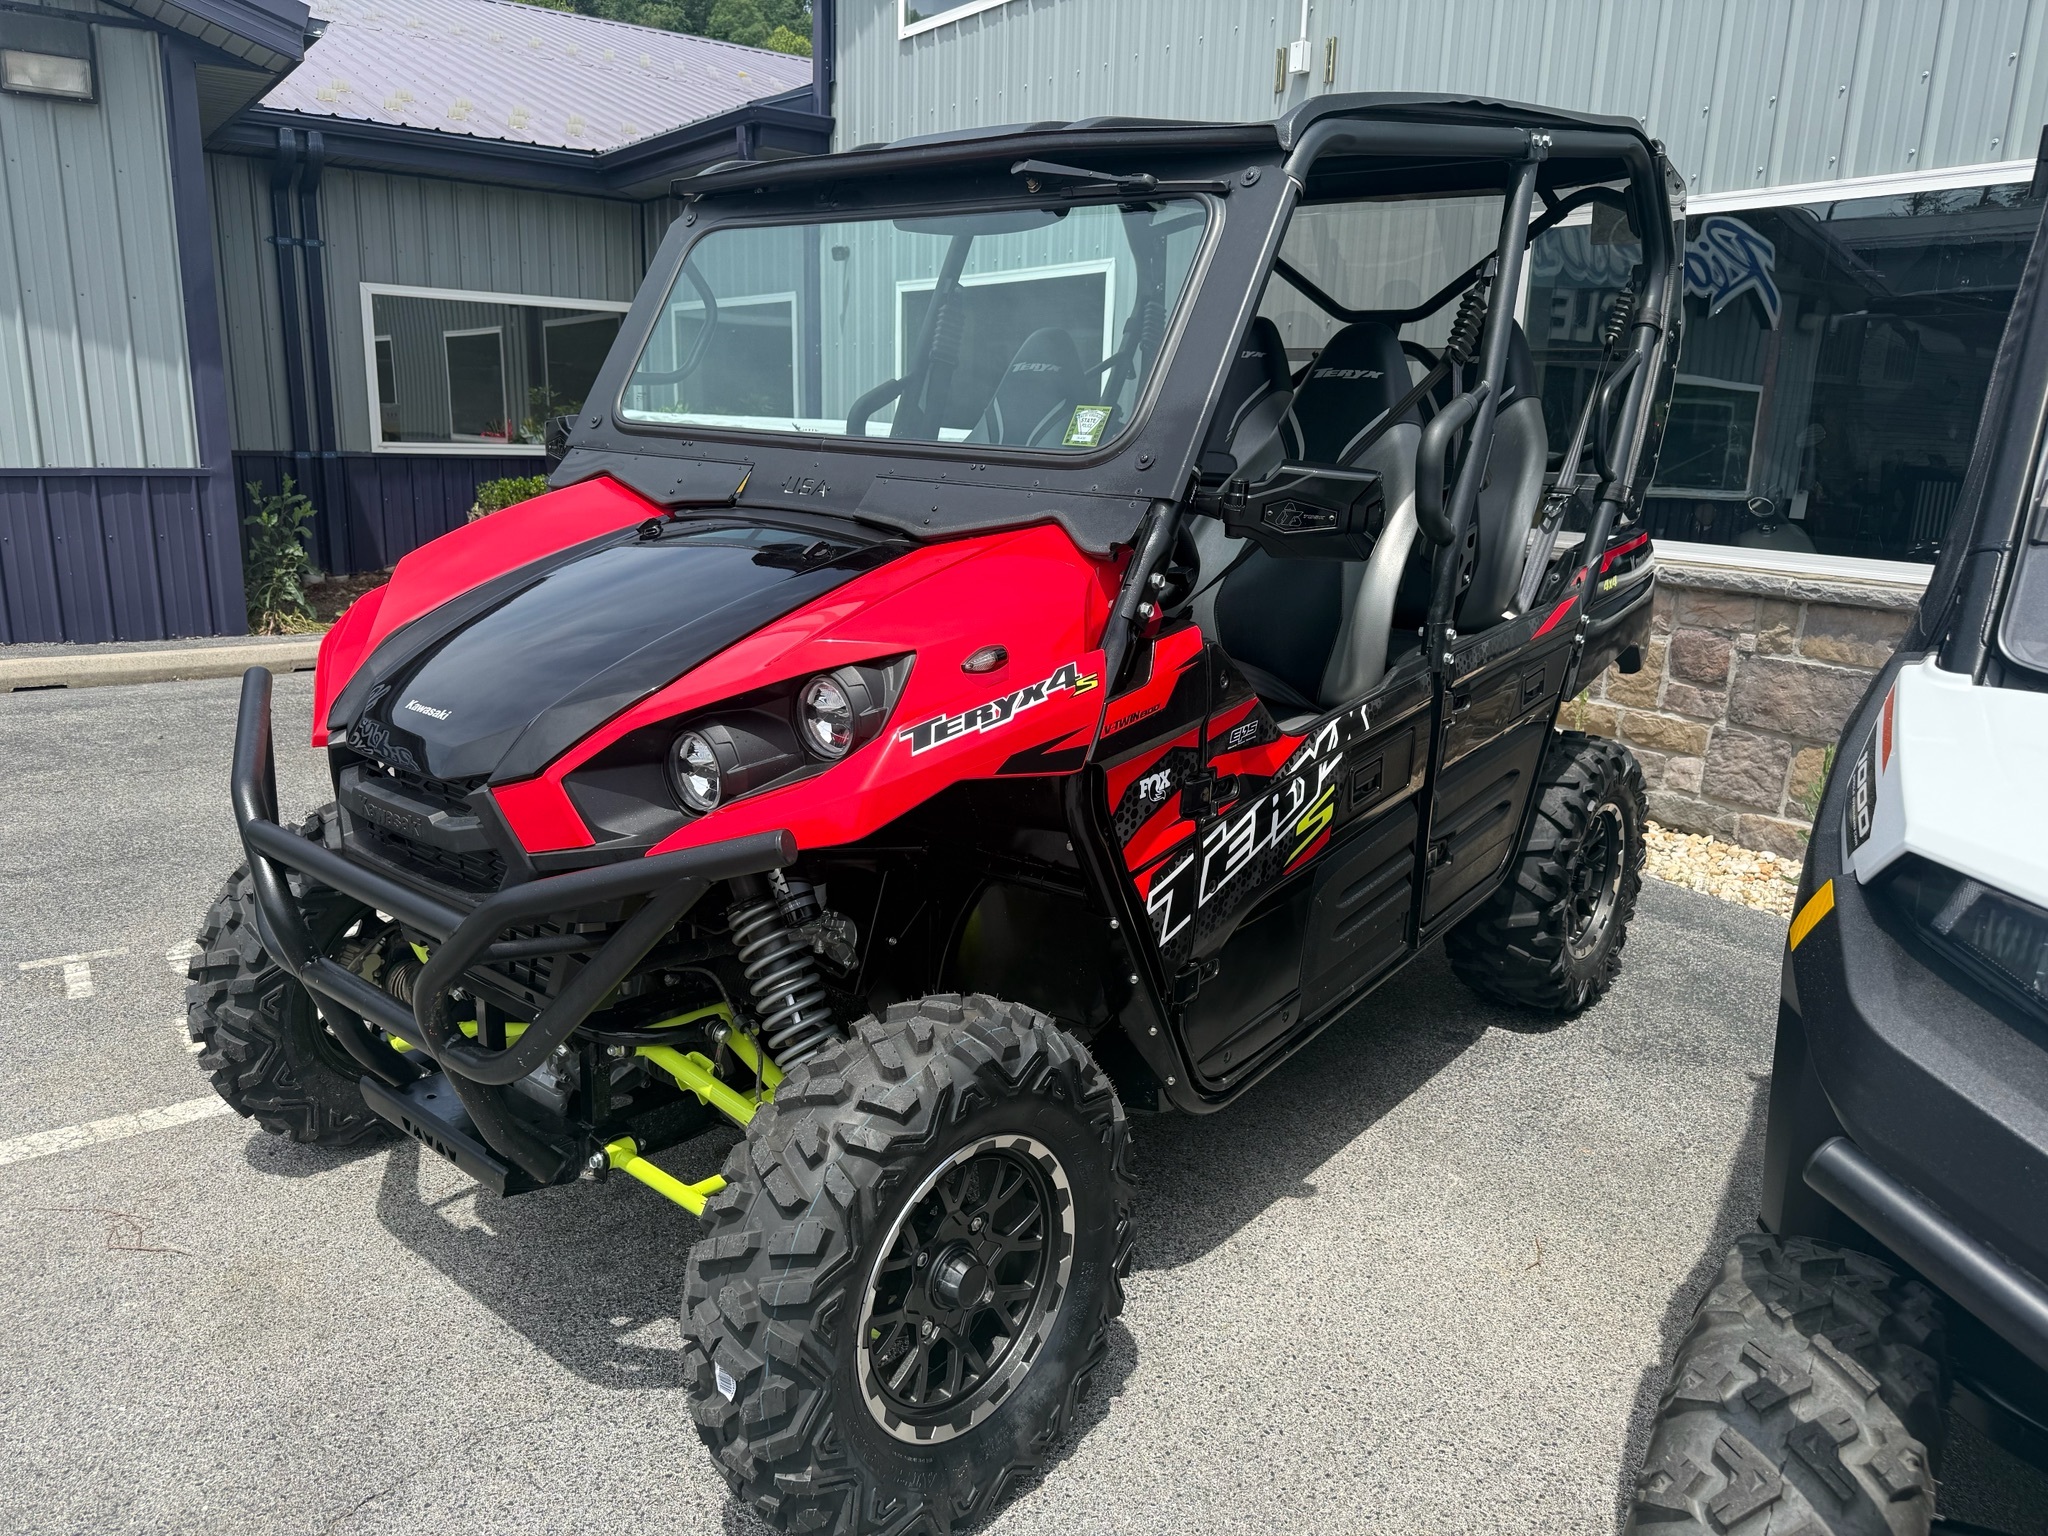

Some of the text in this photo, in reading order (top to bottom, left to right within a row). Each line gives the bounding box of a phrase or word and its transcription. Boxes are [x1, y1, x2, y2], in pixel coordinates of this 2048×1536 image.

[1012, 361, 1062, 373] TERYX
[1313, 367, 1384, 379] TERYX
[783, 475, 826, 498] USA
[1603, 575, 1618, 592] 4x4
[404, 699, 453, 721] Kawasaki
[1139, 768, 1171, 802] FOX
[1857, 751, 1869, 838] 1000
[357, 794, 423, 837] Kawasaki
